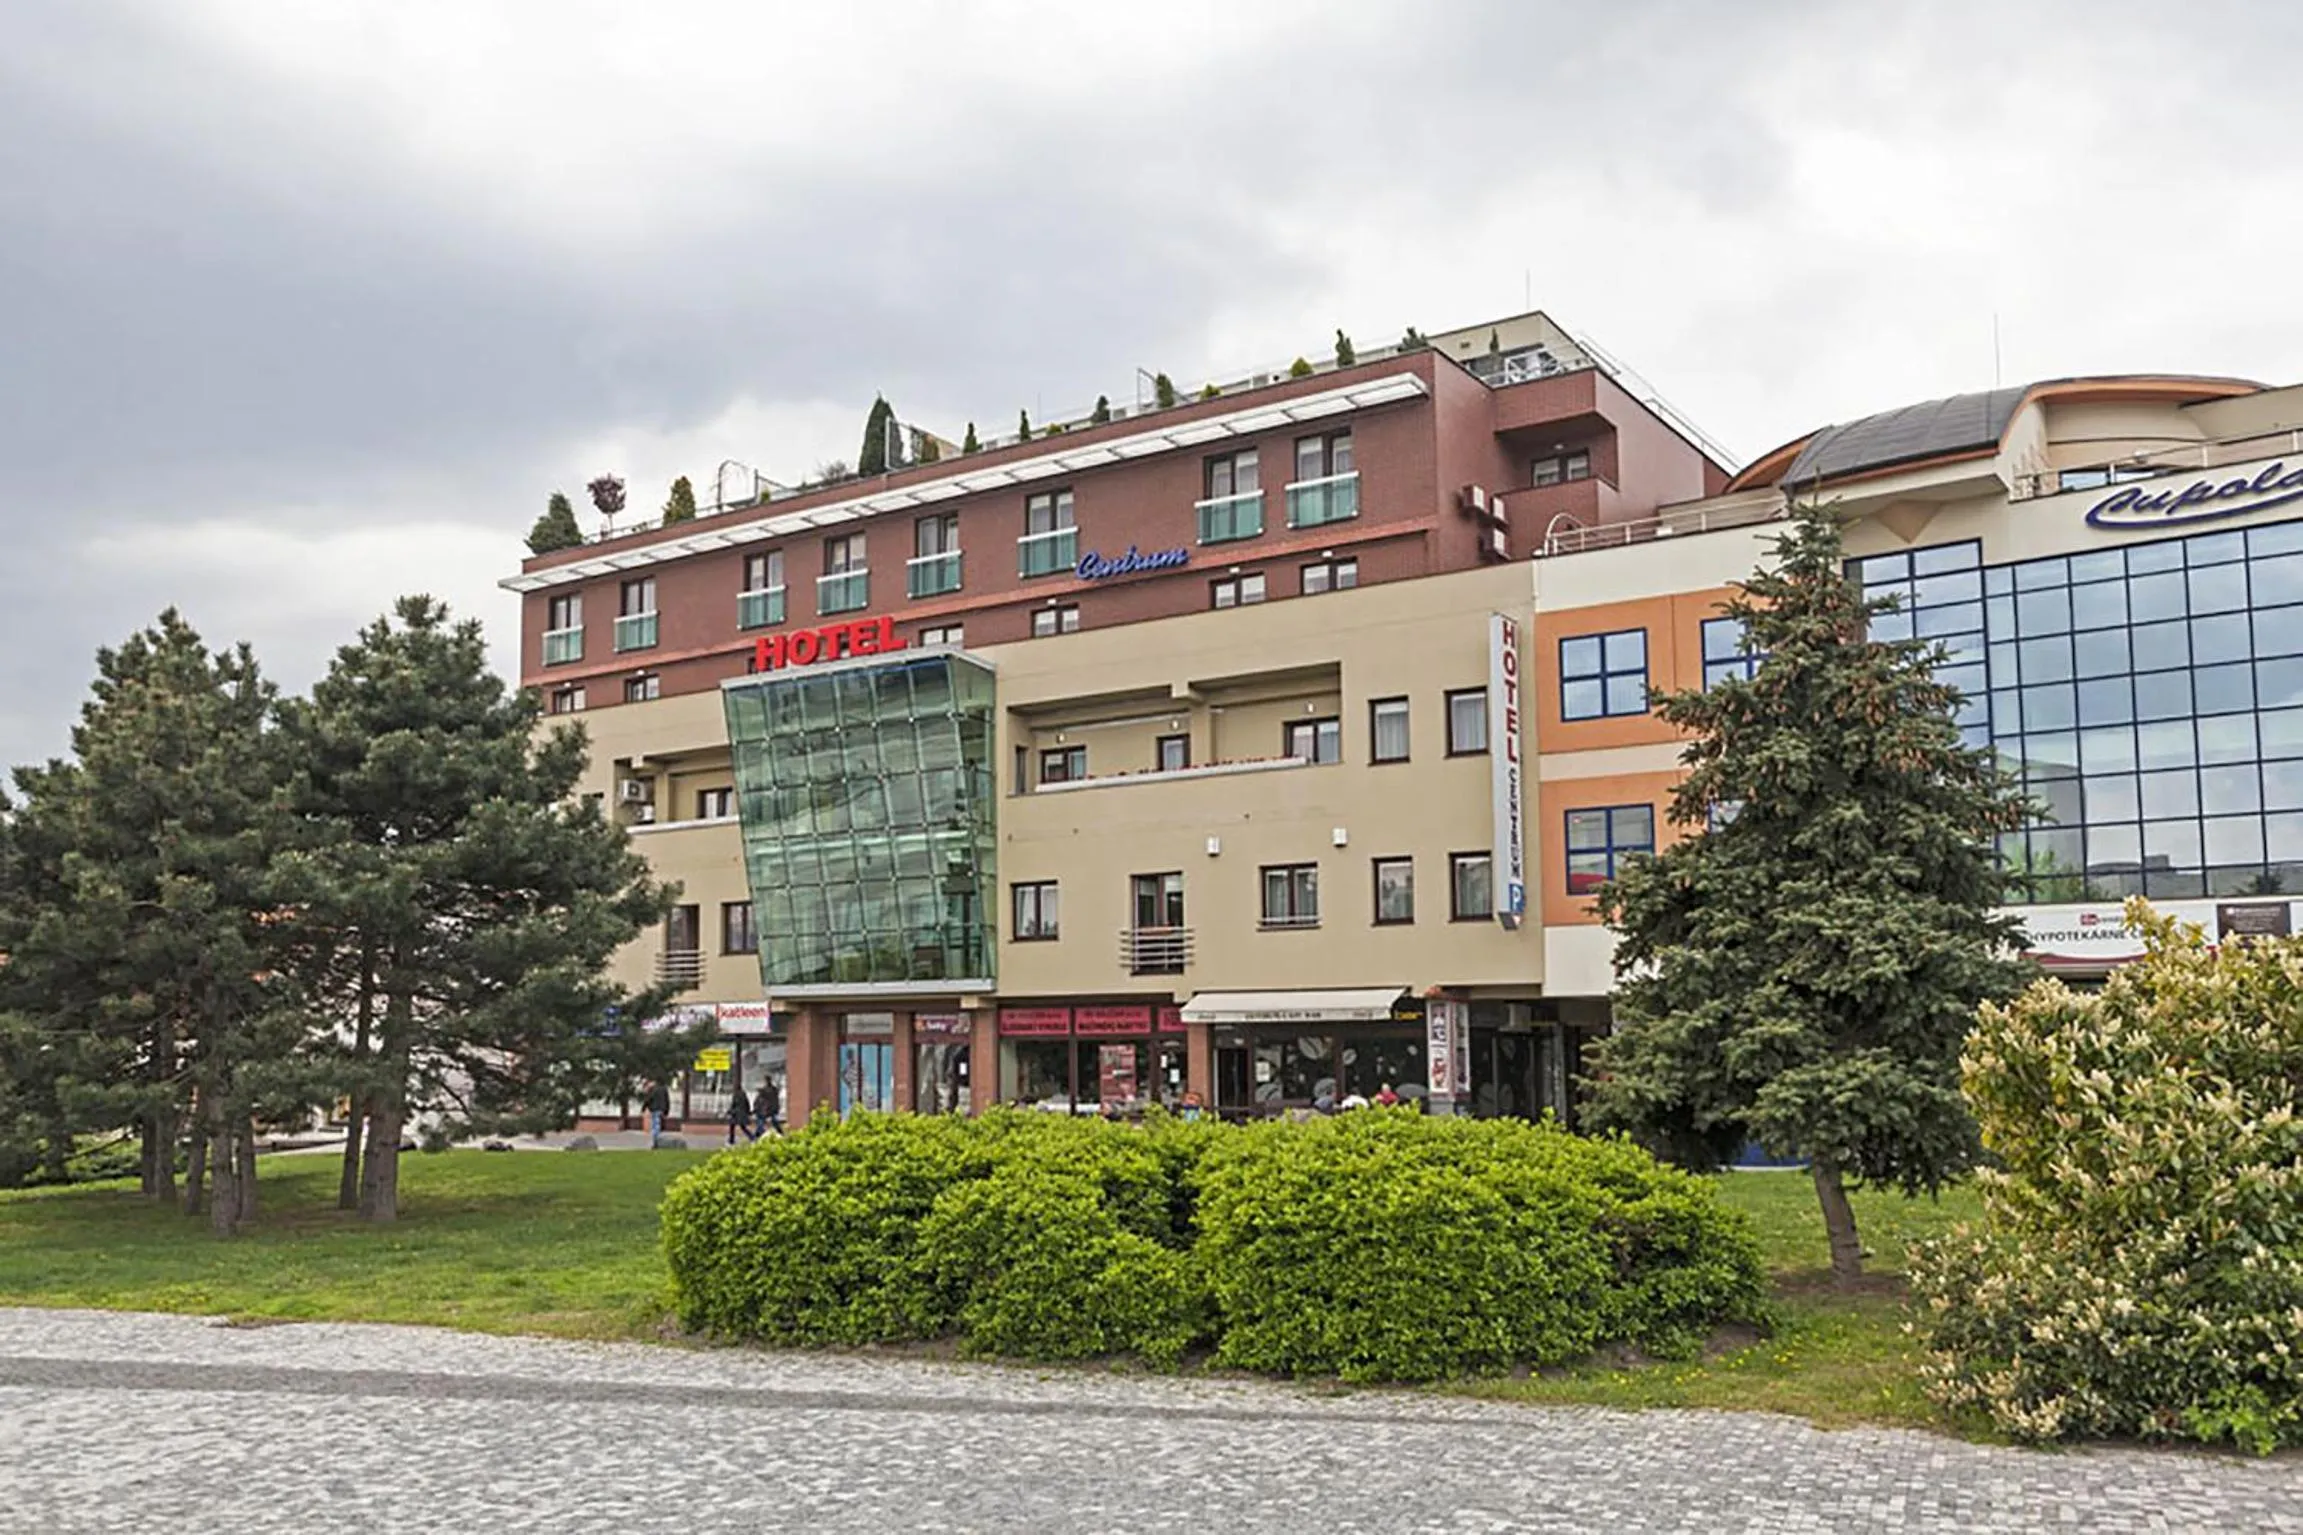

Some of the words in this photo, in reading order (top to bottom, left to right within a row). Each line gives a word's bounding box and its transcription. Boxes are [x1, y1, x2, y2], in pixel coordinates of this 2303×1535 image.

[1077, 545, 1190, 580] Centrum
[755, 616, 909, 671] HOTEL
[1502, 620, 1520, 763] HOTEL
[1508, 767, 1521, 879] CENTRUM
